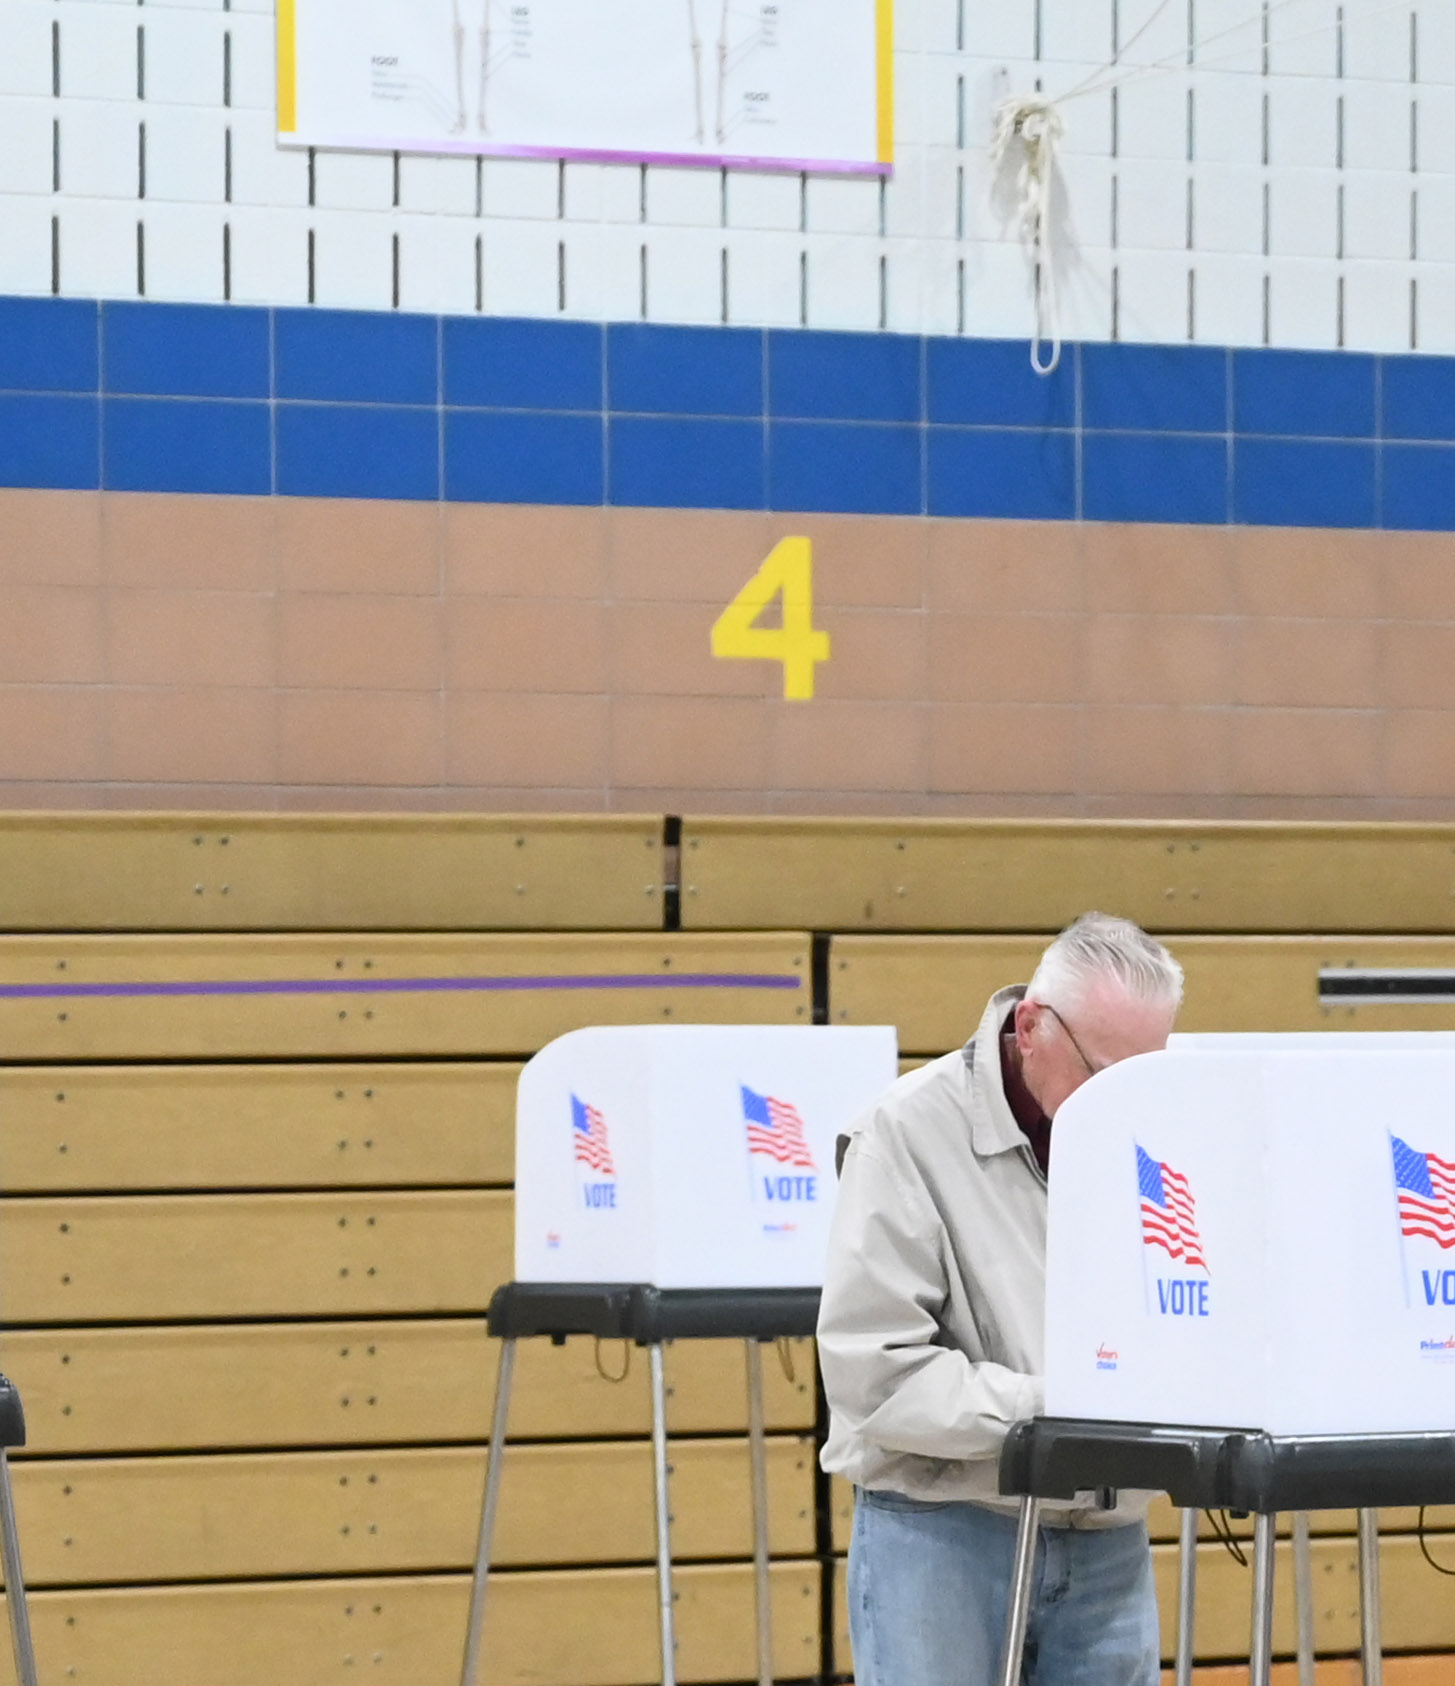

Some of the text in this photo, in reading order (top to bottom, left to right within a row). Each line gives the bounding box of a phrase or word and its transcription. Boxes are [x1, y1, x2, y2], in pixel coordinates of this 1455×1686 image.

[711, 535, 830, 700] 4
[584, 1183, 617, 1208] VOTE
[764, 1176, 817, 1201] VOTE
[1157, 1279, 1209, 1316] VOTE
